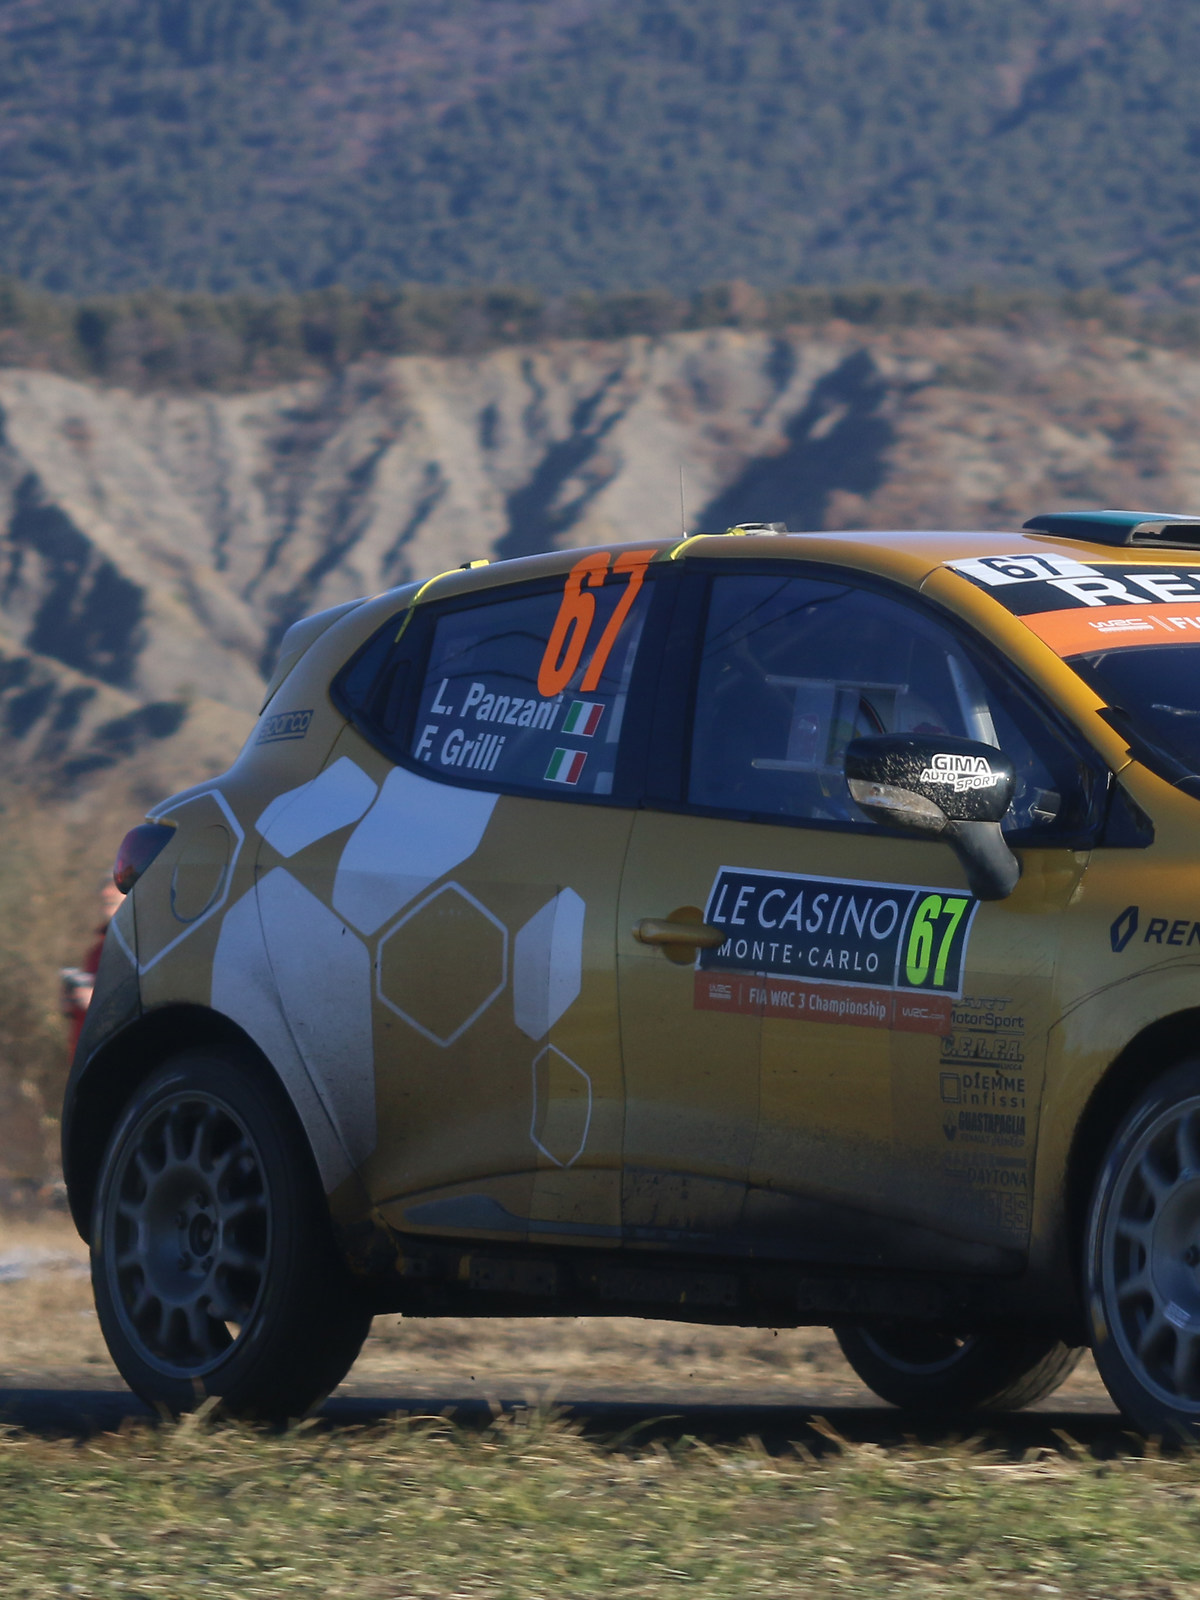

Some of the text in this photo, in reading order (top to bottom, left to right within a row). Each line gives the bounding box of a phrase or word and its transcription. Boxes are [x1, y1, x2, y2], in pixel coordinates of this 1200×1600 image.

[978, 555, 1063, 579] 67
[537, 549, 658, 697] 67
[1088, 618, 1149, 630] WRC
[430, 678, 564, 731] L. Panzani
[414, 724, 506, 771] F. Grilli
[922, 771, 998, 791] AUTO SPORT
[933, 756, 989, 773] GIMA
[713, 884, 899, 940] LE CASINO
[905, 894, 968, 986] 67
[749, 987, 887, 1020] FIA WRC 3 Championship
[967, 1168, 1028, 1188] DAYTONA
